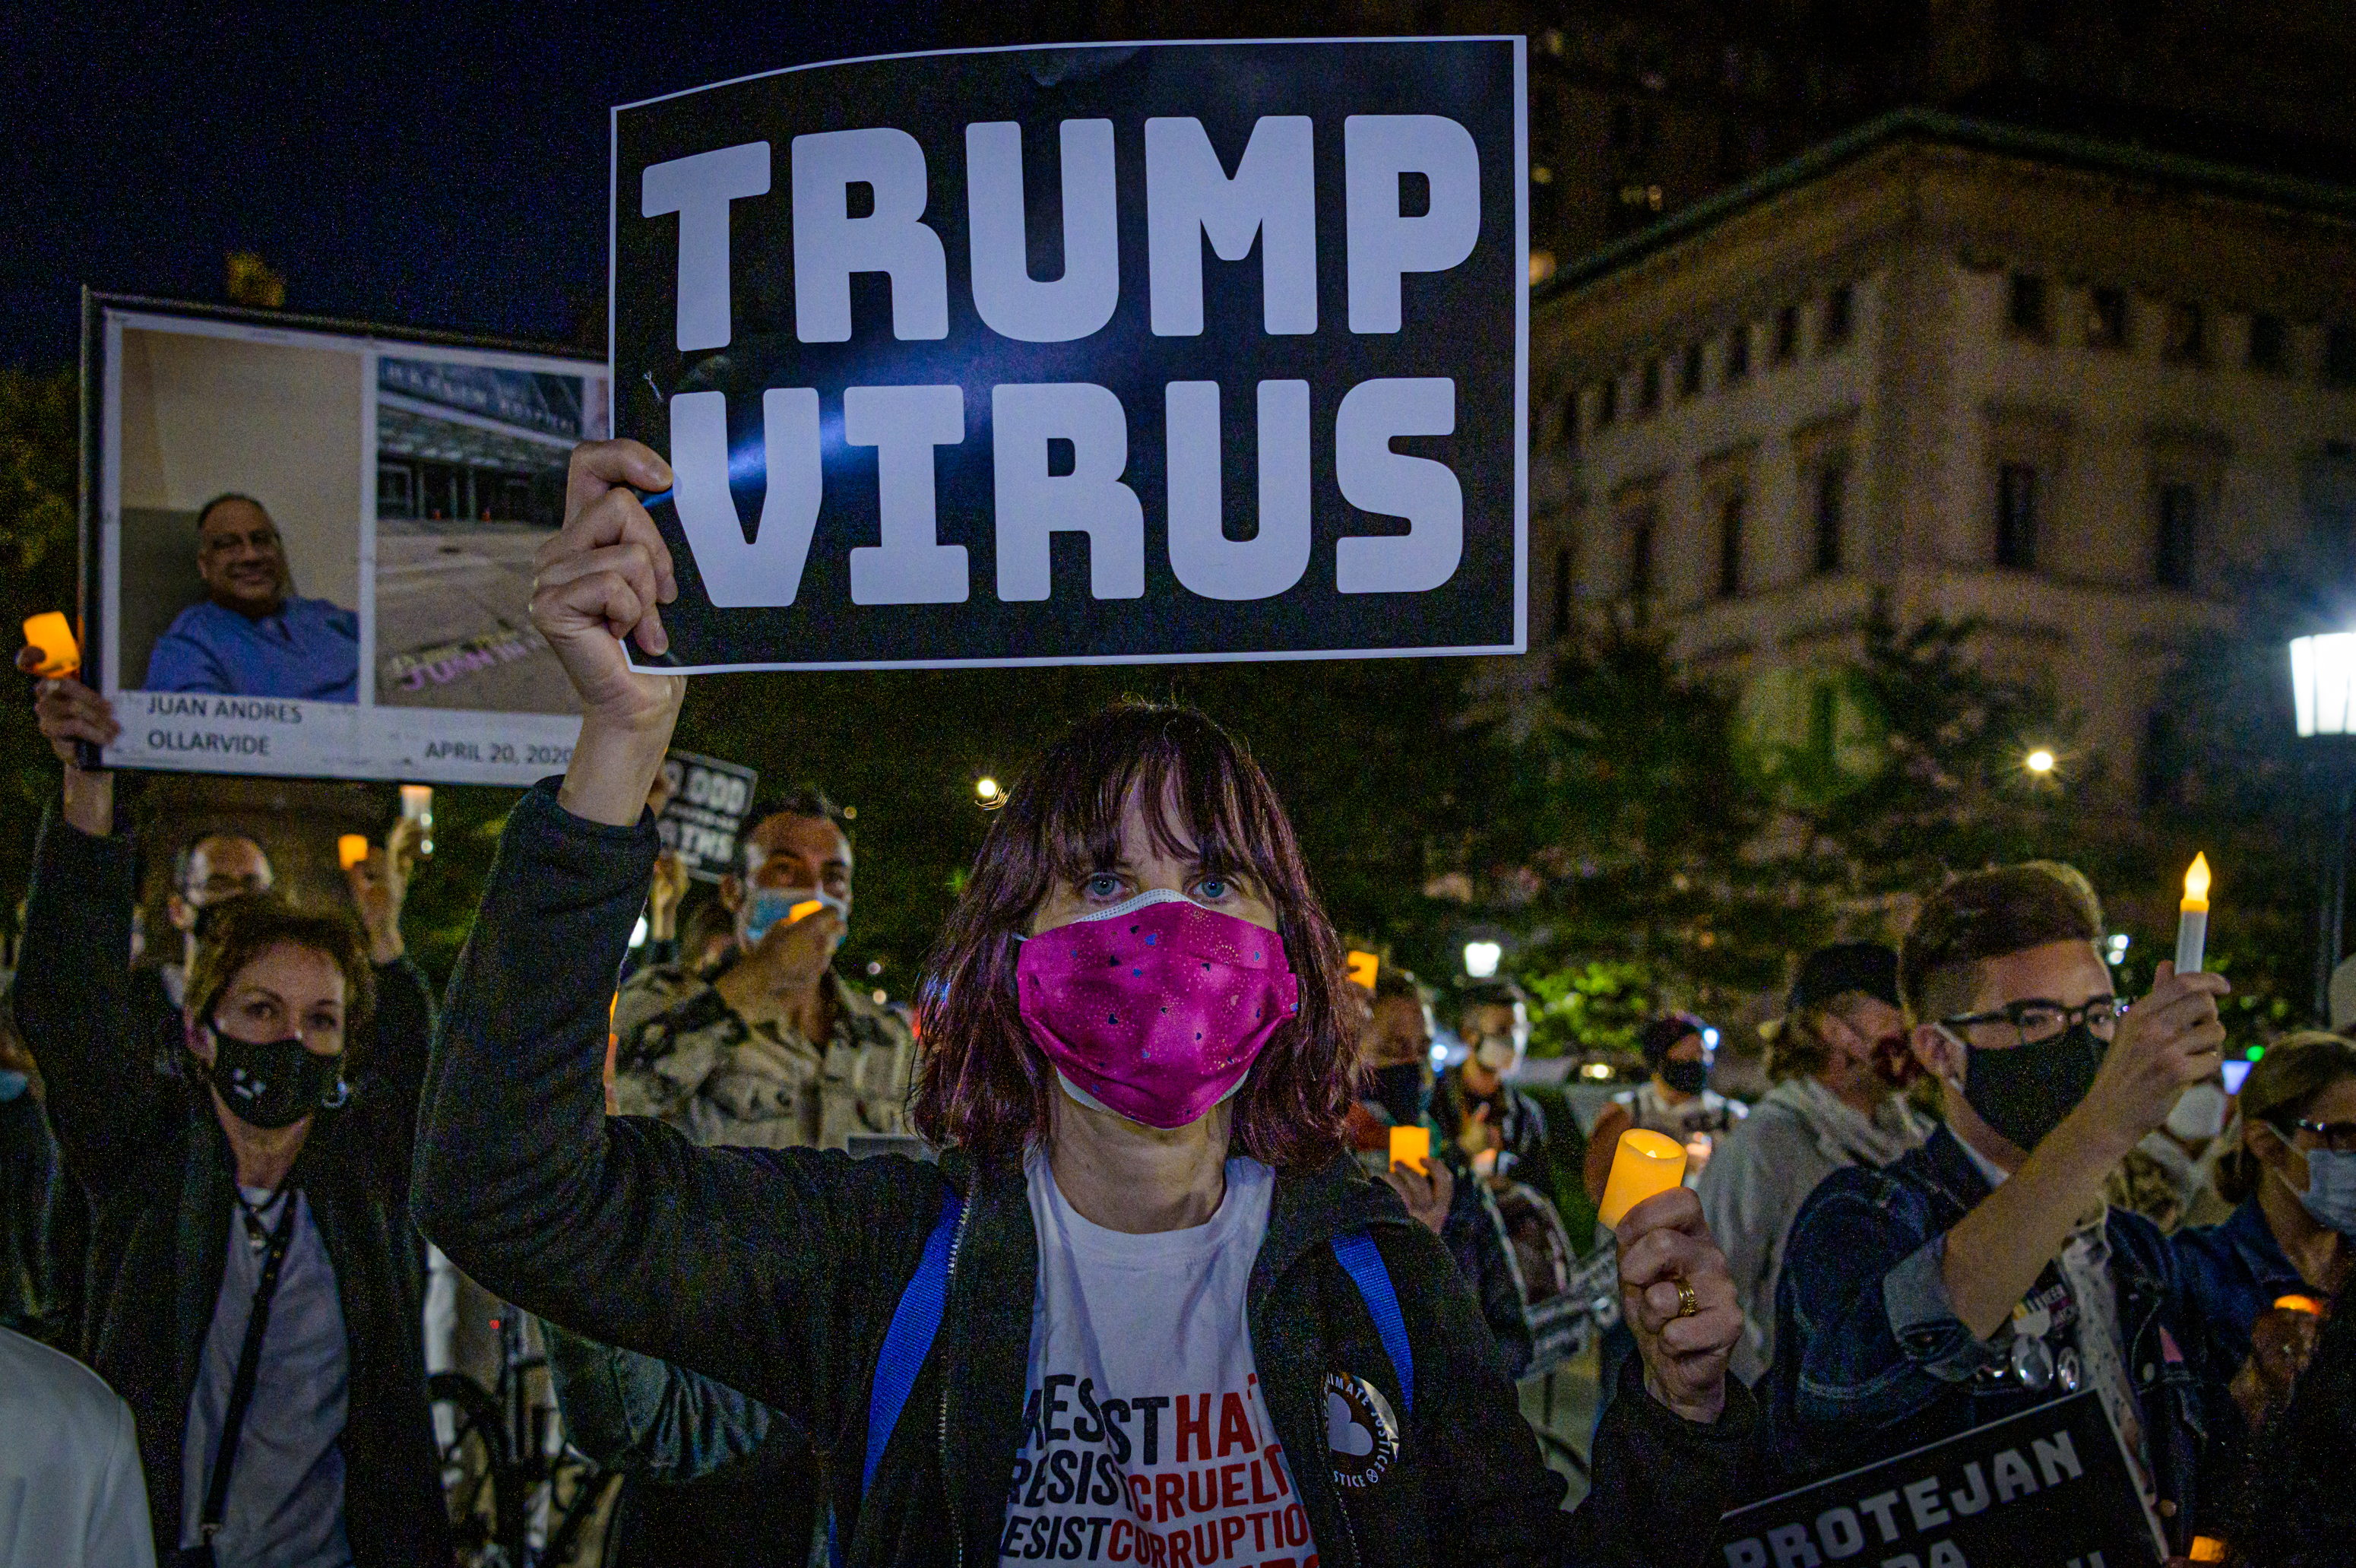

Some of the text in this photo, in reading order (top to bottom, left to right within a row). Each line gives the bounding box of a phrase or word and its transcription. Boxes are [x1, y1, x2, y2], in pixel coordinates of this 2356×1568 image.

[641, 115, 1480, 351] TRUMP
[670, 377, 1464, 607] VIRUS
[147, 728, 271, 756] OLLARVIDE
[149, 695, 303, 724] JUAN ANDRES
[425, 740, 480, 761] APRIL
[1024, 1373, 1170, 1465] RESST
[1175, 1373, 1263, 1462] HA
[1326, 1372, 1392, 1473] IMATE JUSTICE
[1128, 1444, 1289, 1523] CRUELT
[1333, 1470, 1366, 1488] STICE
[1723, 1429, 2084, 1568] PROTEJAN
[999, 1503, 1315, 1568] ESIST CORRUPTIO
